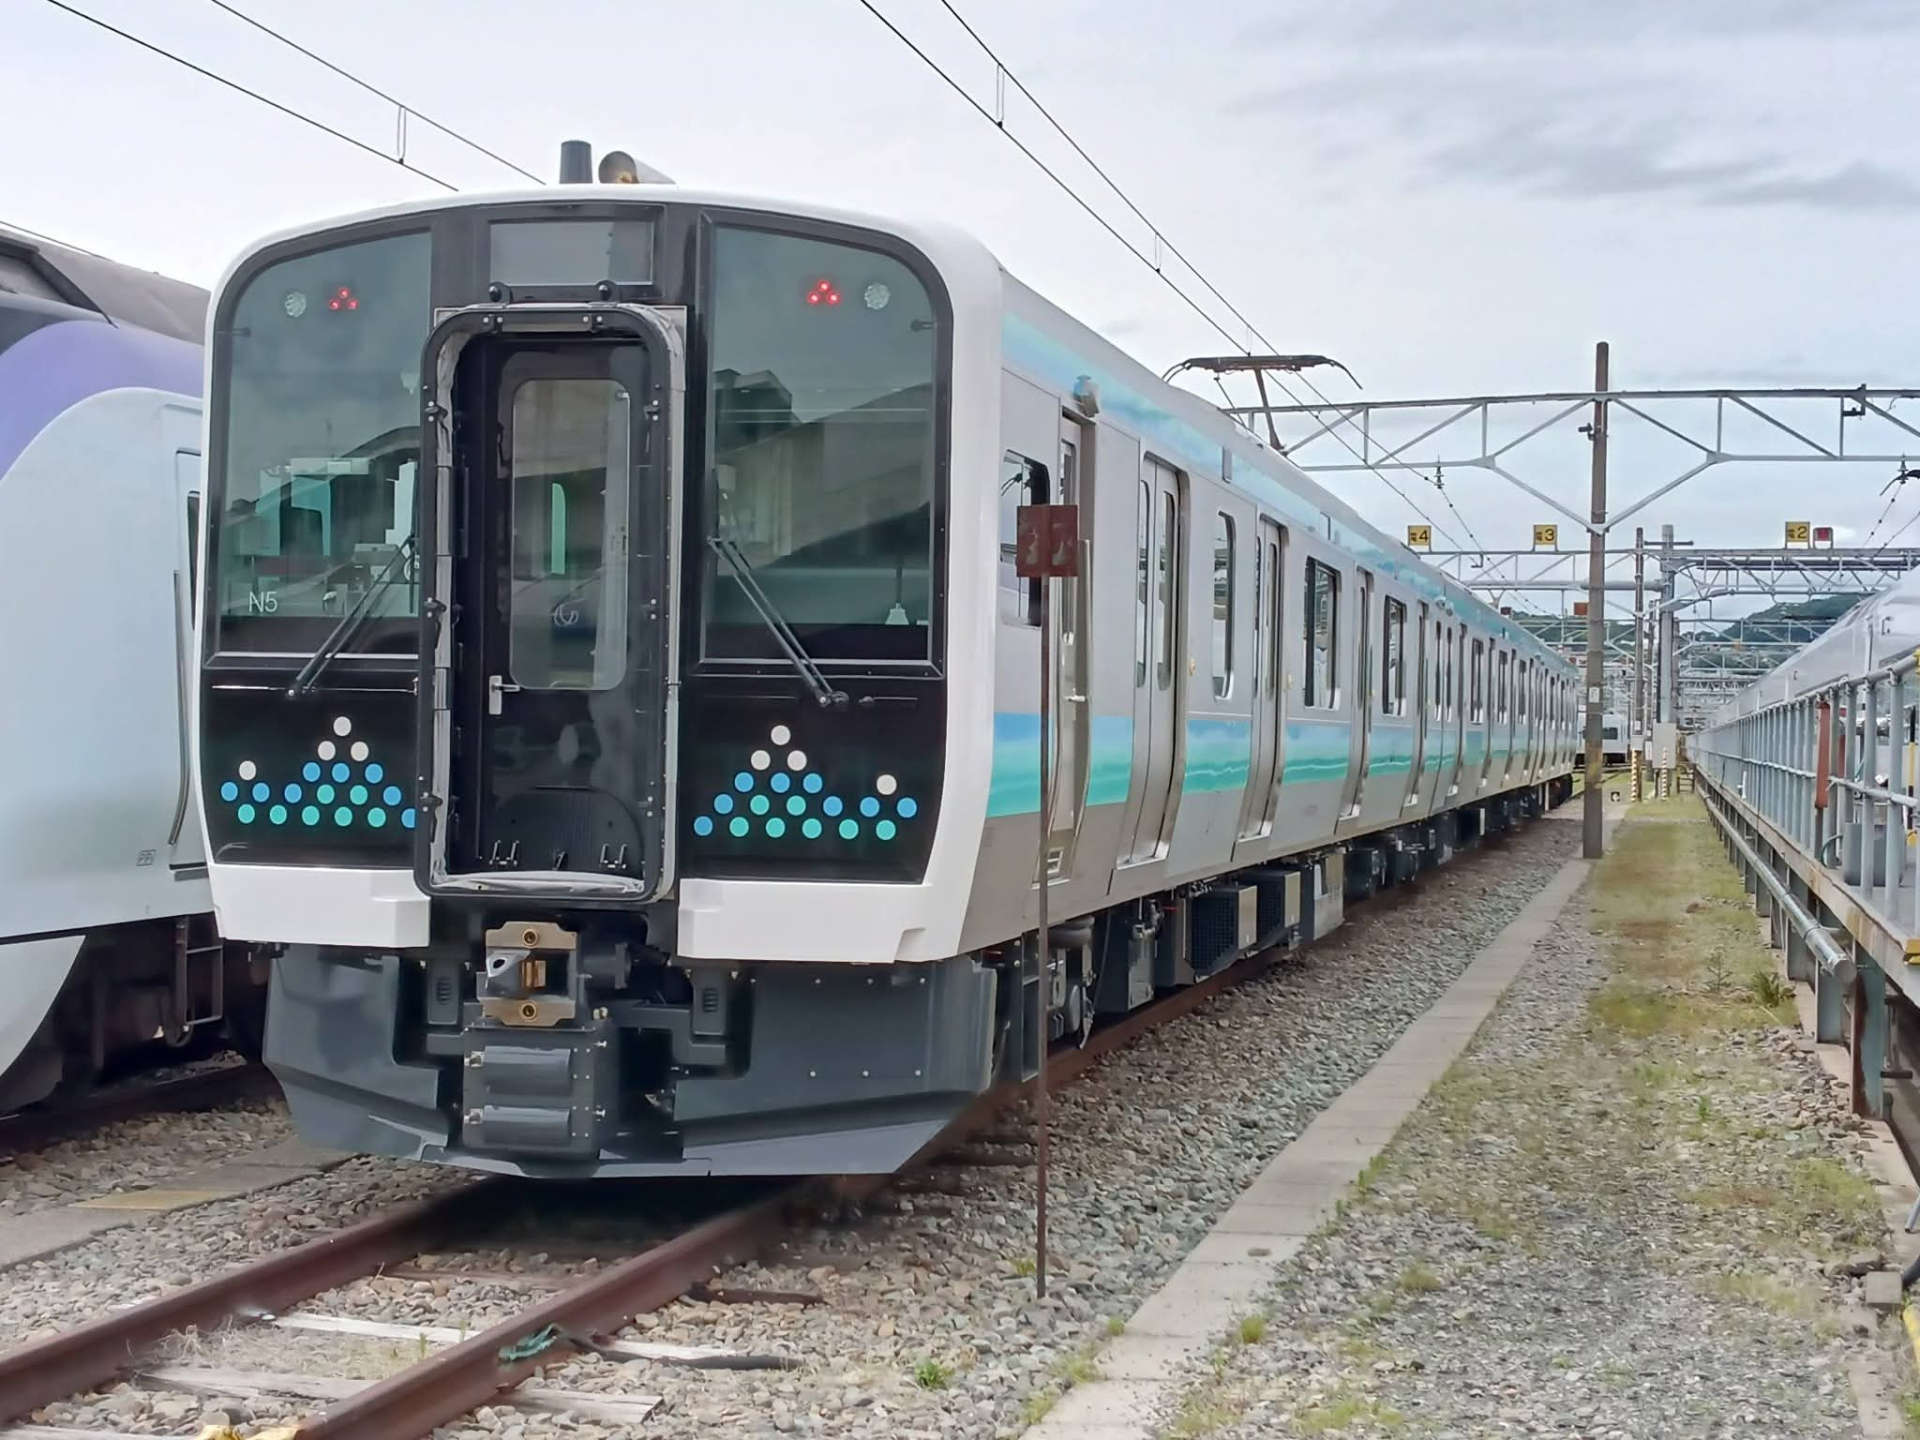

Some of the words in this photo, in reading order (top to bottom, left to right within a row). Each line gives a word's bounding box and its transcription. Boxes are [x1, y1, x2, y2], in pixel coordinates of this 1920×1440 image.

[1419, 529, 1429, 542] 4
[1545, 528, 1555, 541] 3
[1798, 526, 1807, 539] 2
[248, 591, 278, 613] N5
